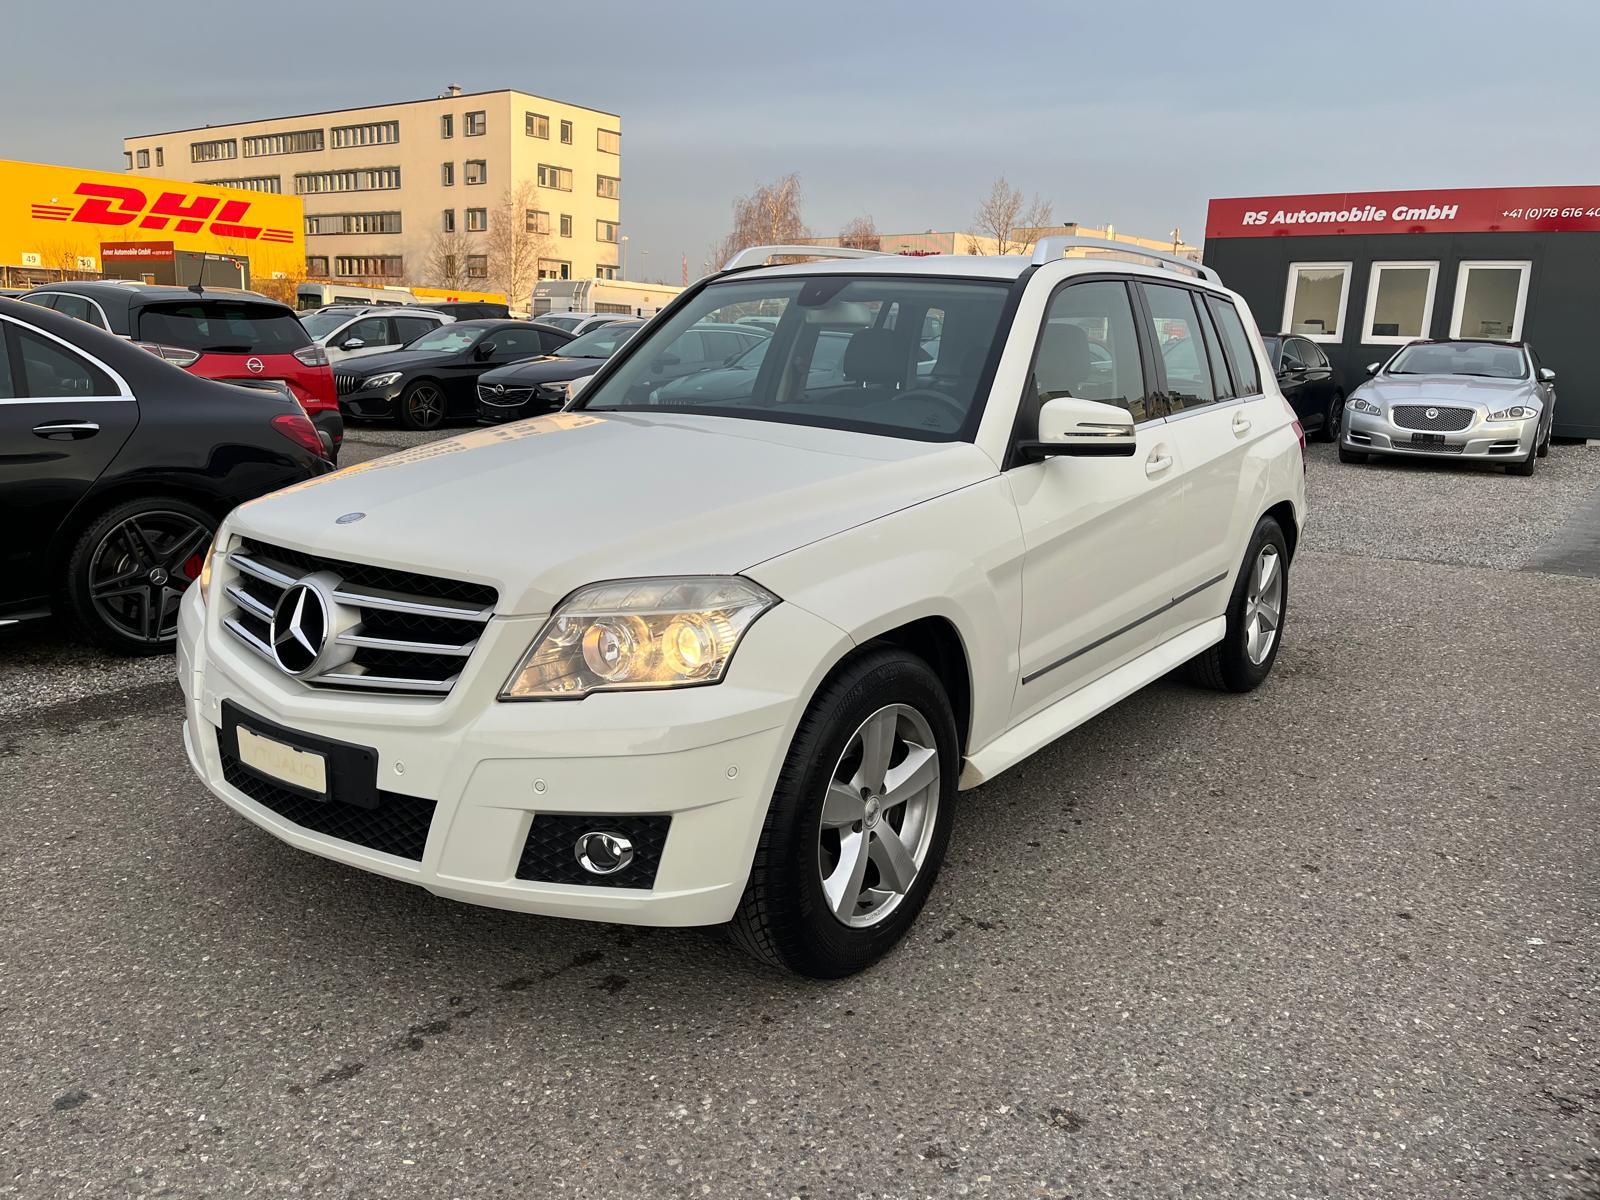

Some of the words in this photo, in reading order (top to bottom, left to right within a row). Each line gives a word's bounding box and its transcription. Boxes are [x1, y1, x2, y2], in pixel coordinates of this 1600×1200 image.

[71, 182, 263, 240] DHL
[1242, 210, 1269, 226] RS
[1270, 205, 1387, 225] Automobile
[1391, 204, 1459, 221] GmbH
[1502, 208, 1523, 219] +41
[1525, 207, 1559, 221] (0)78
[1561, 207, 1584, 218] 616
[113, 247, 138, 256] Automobile
[137, 247, 152, 256] GmbH
[26, 255, 37, 263] 49
